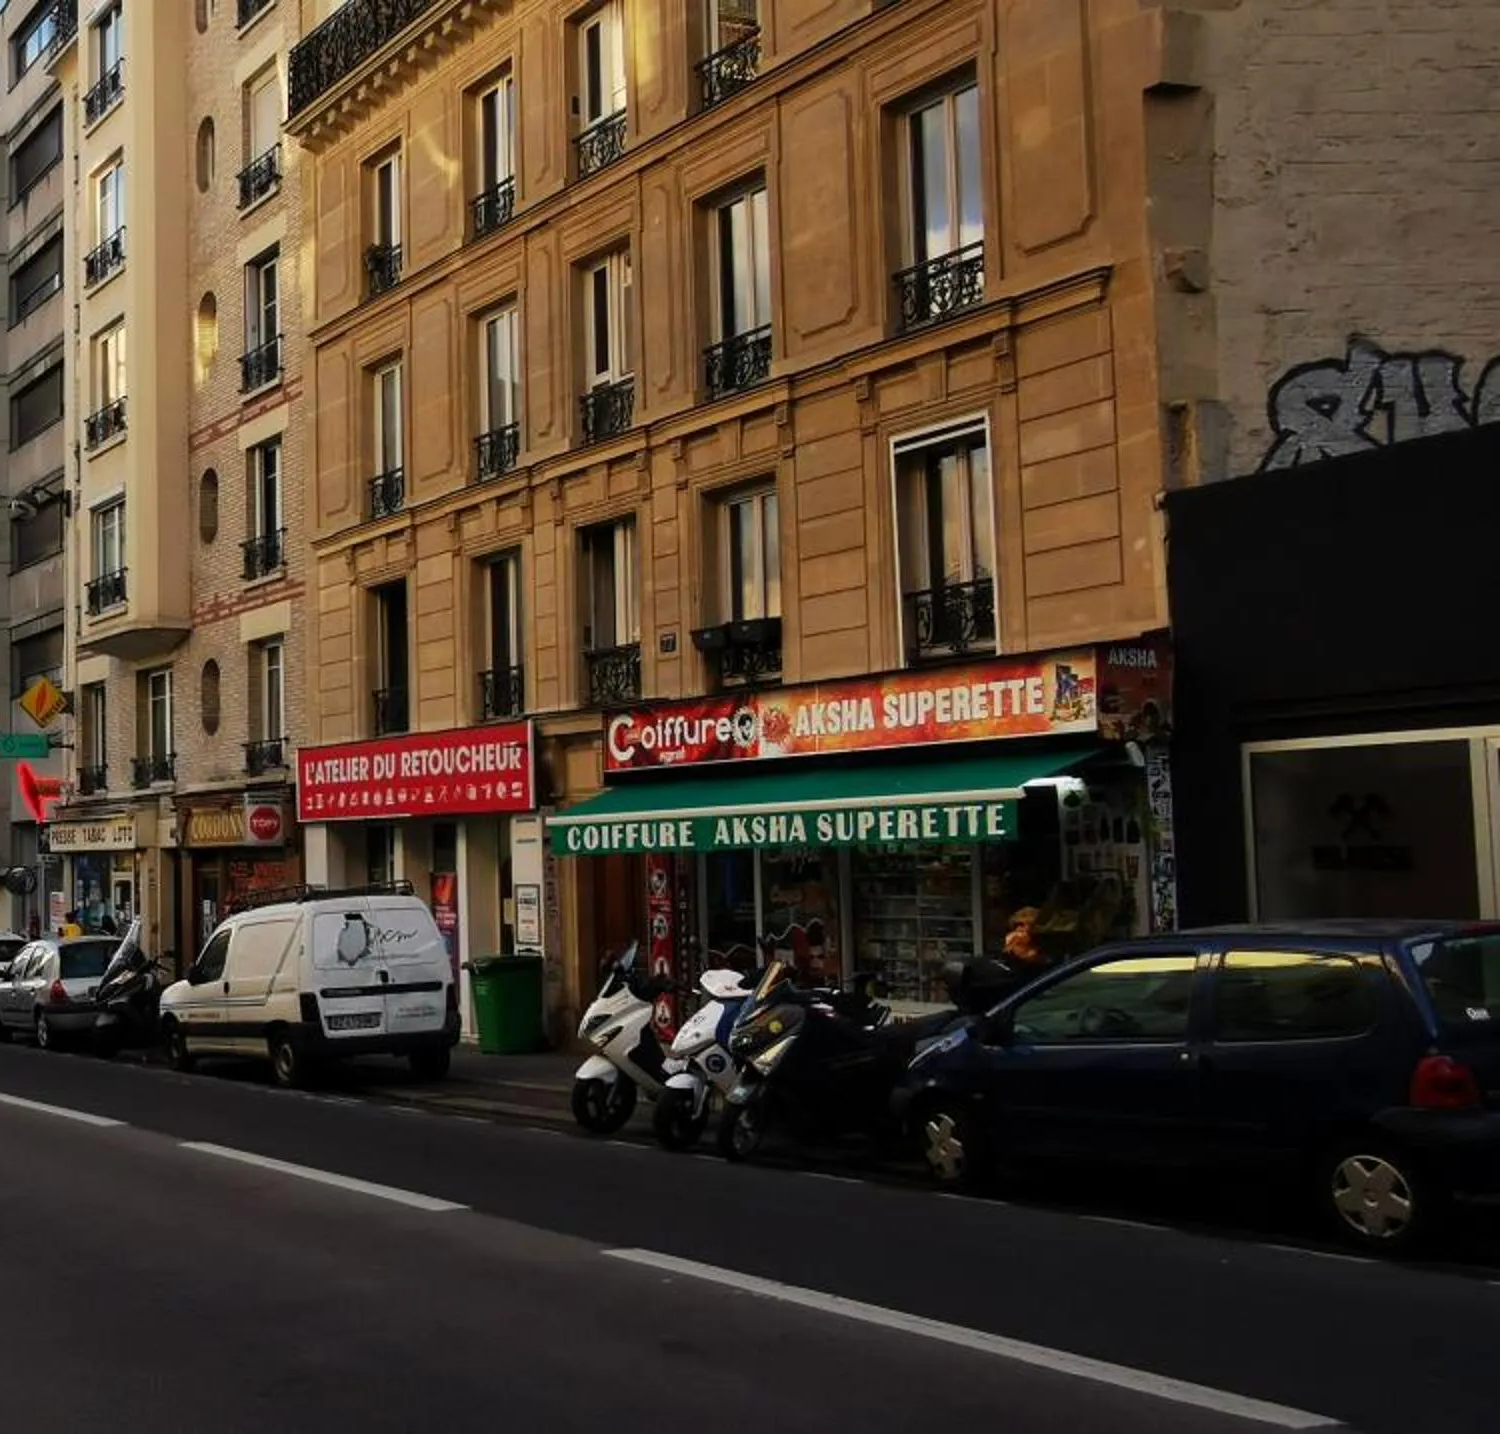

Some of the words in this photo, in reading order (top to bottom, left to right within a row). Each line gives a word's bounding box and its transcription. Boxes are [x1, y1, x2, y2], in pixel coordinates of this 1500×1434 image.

[1108, 646, 1157, 669] AKSHA
[795, 697, 875, 738] AKSHA
[883, 676, 1046, 729] SUPERETTE
[608, 713, 732, 762] Coiffure
[305, 756, 369, 786] L'ATELIER
[373, 752, 395, 780] DU
[401, 741, 522, 778] RETOUCHEUR
[567, 820, 695, 852] COIFFURE
[714, 814, 806, 847] AKSHA
[817, 803, 1006, 846] SUPERETTE
